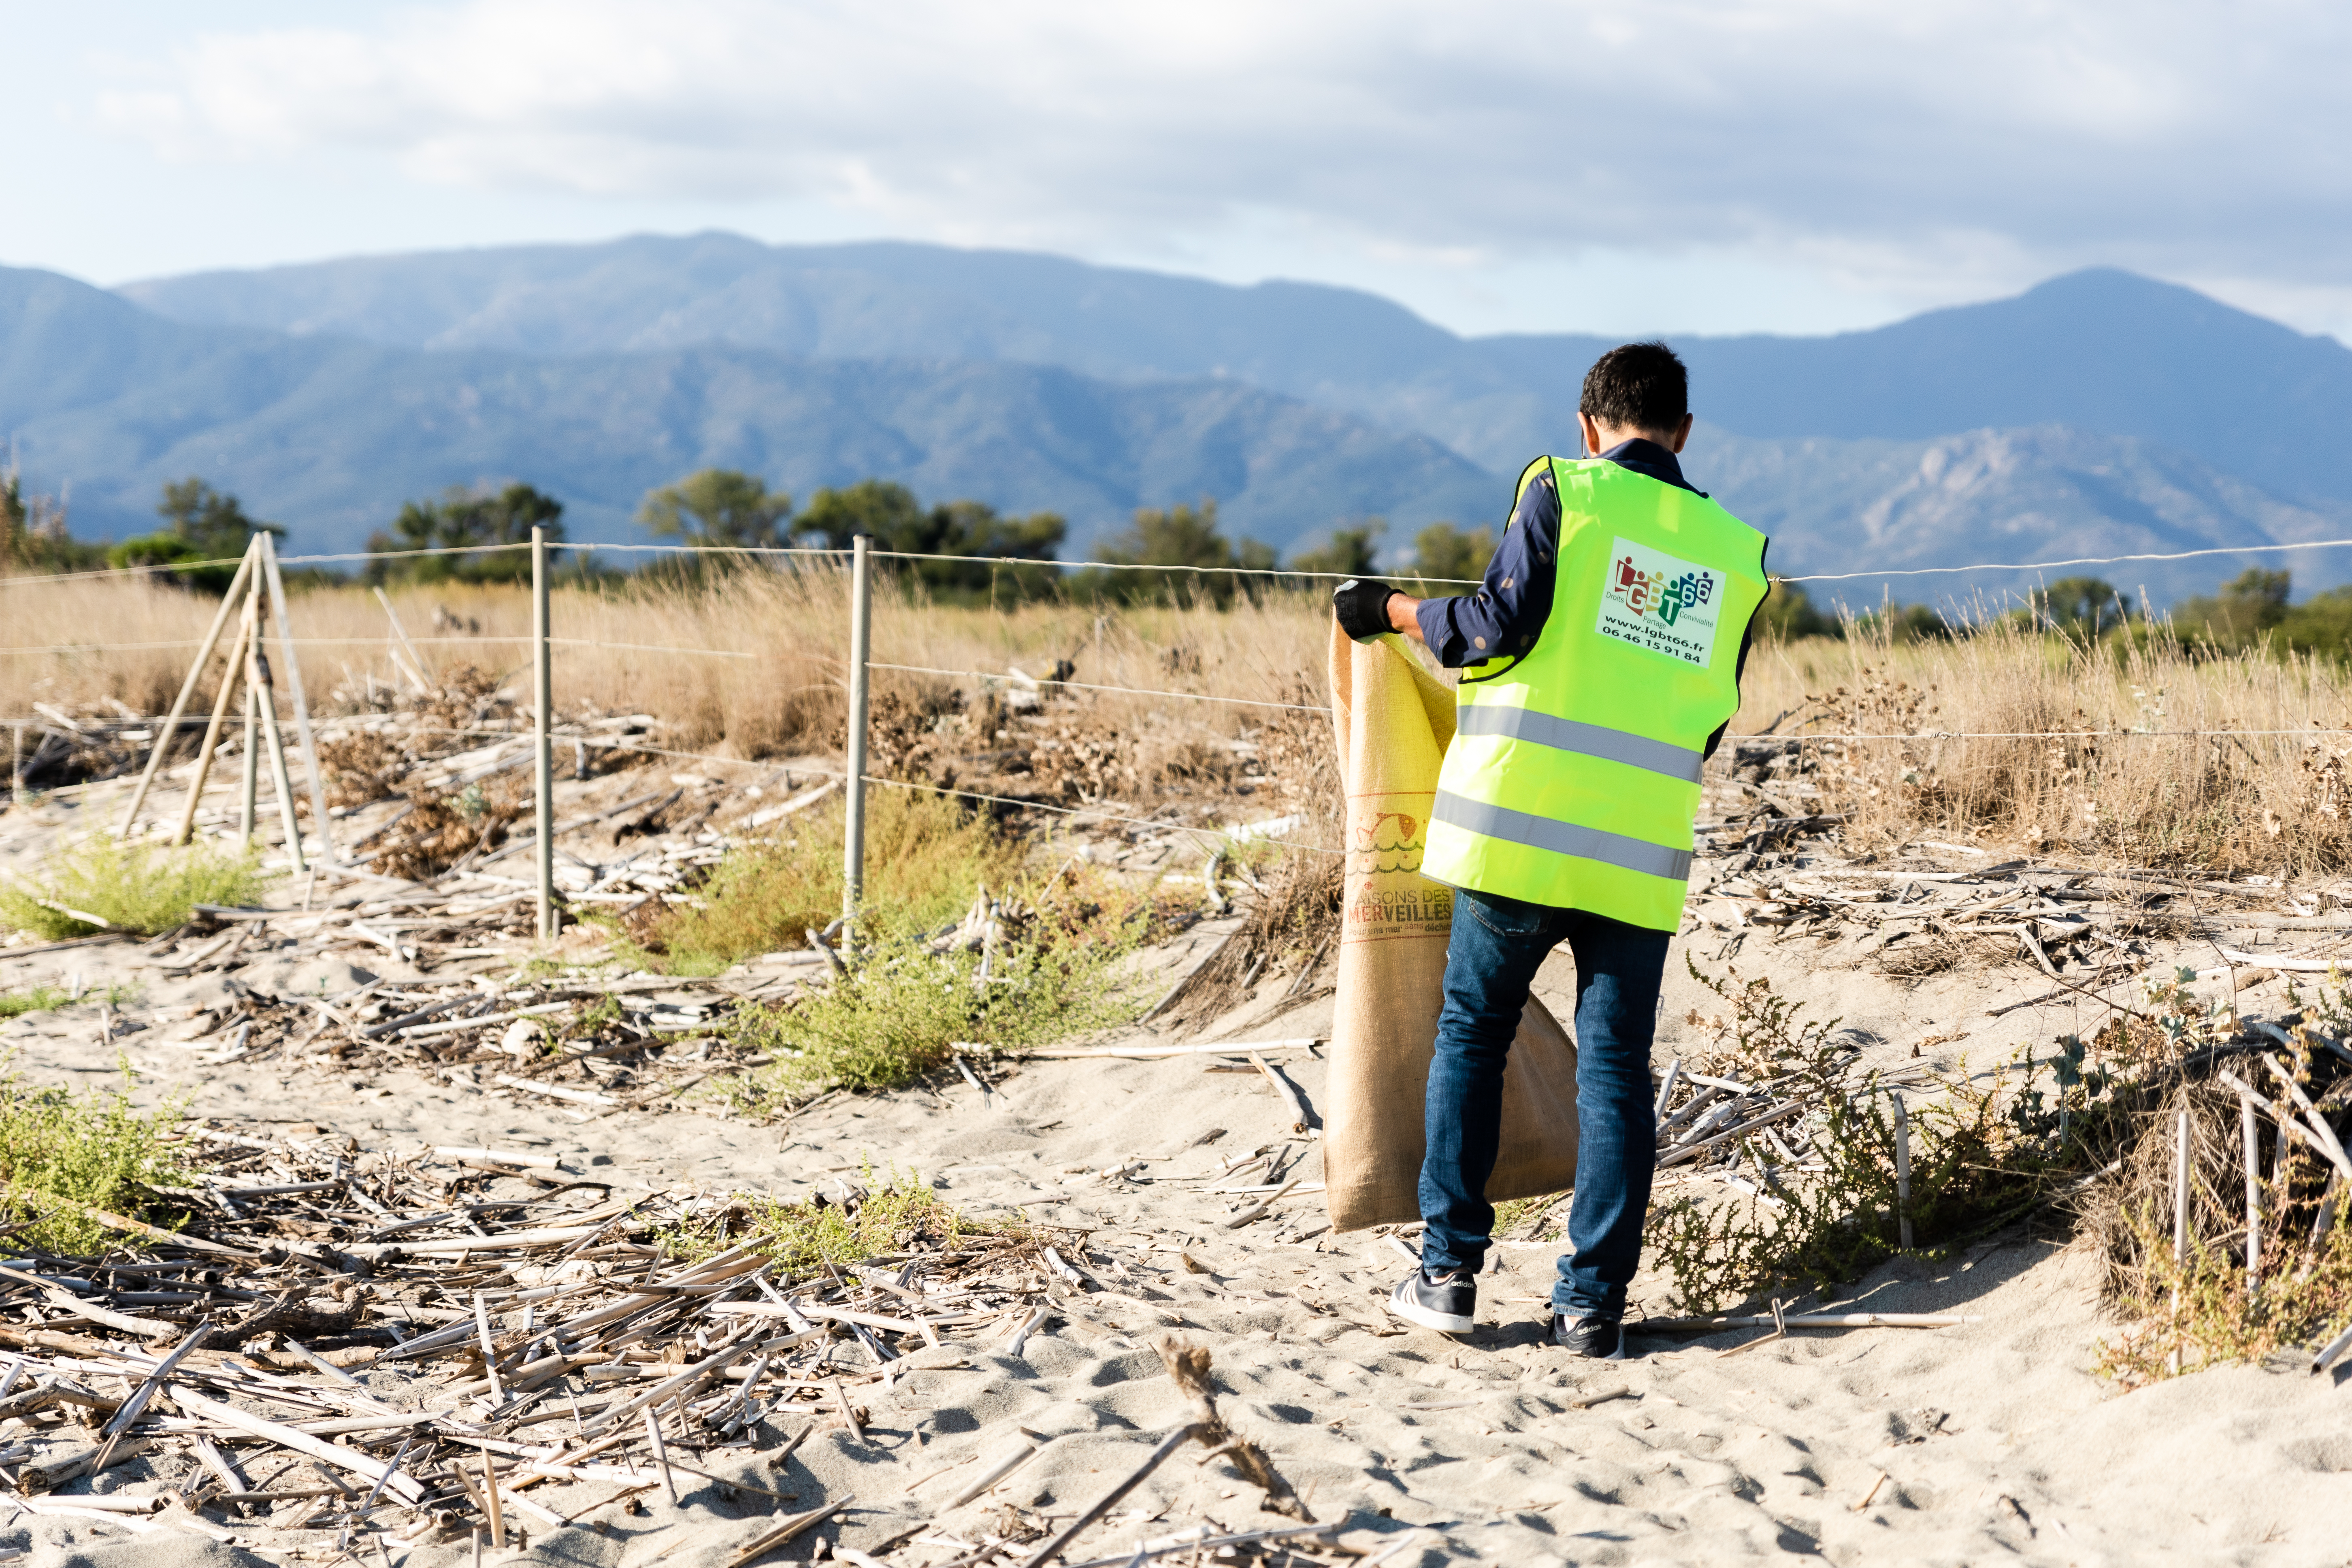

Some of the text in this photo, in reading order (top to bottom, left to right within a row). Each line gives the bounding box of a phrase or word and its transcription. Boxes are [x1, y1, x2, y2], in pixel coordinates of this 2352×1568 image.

[1606, 591, 1624, 603] Droits
[1643, 616, 1666, 629] Partage
[1680, 611, 1713, 628] Convivialité
[1605, 615, 1704, 652] www.lgbt66.fr
[1603, 626, 1700, 663] 06 46 15 91 84
[1348, 889, 1450, 907] FAISONS DES
[1349, 903, 1451, 923] MERVEILLES
[1577, 1324, 1602, 1336] adidas
